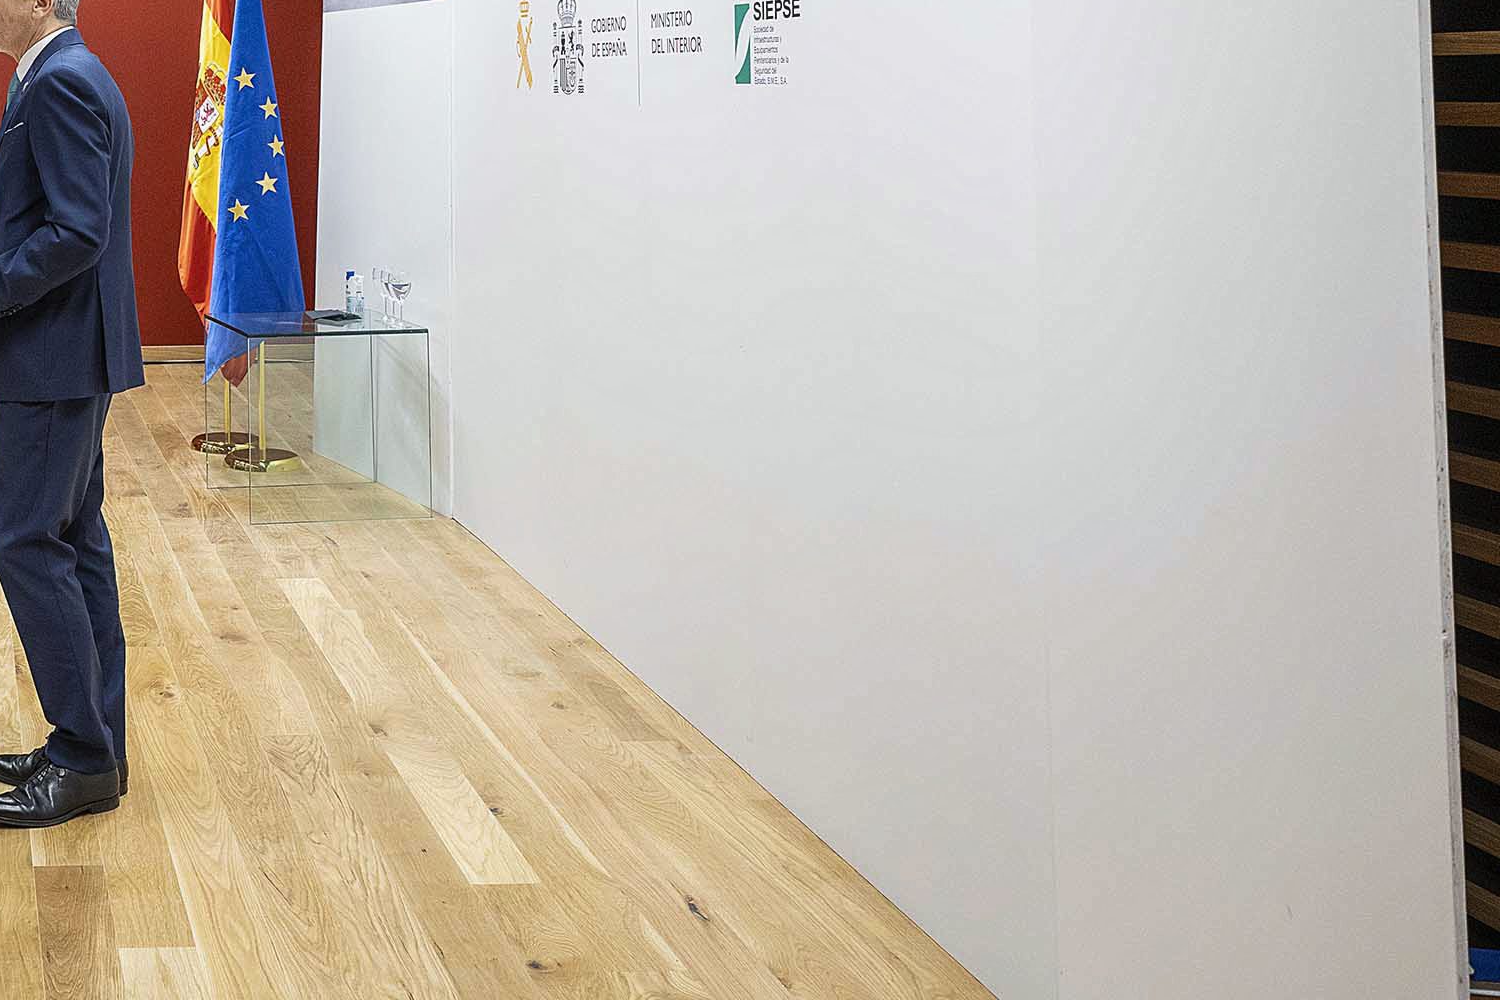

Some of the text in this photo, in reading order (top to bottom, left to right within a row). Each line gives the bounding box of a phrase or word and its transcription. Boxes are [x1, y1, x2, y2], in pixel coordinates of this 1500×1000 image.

[590, 15, 627, 34] GOBIERNO
[650, 9, 693, 29] MINISTERIO
[591, 37, 628, 58] DE ESPAÑA
[651, 36, 703, 54] DEL INTERIOR
